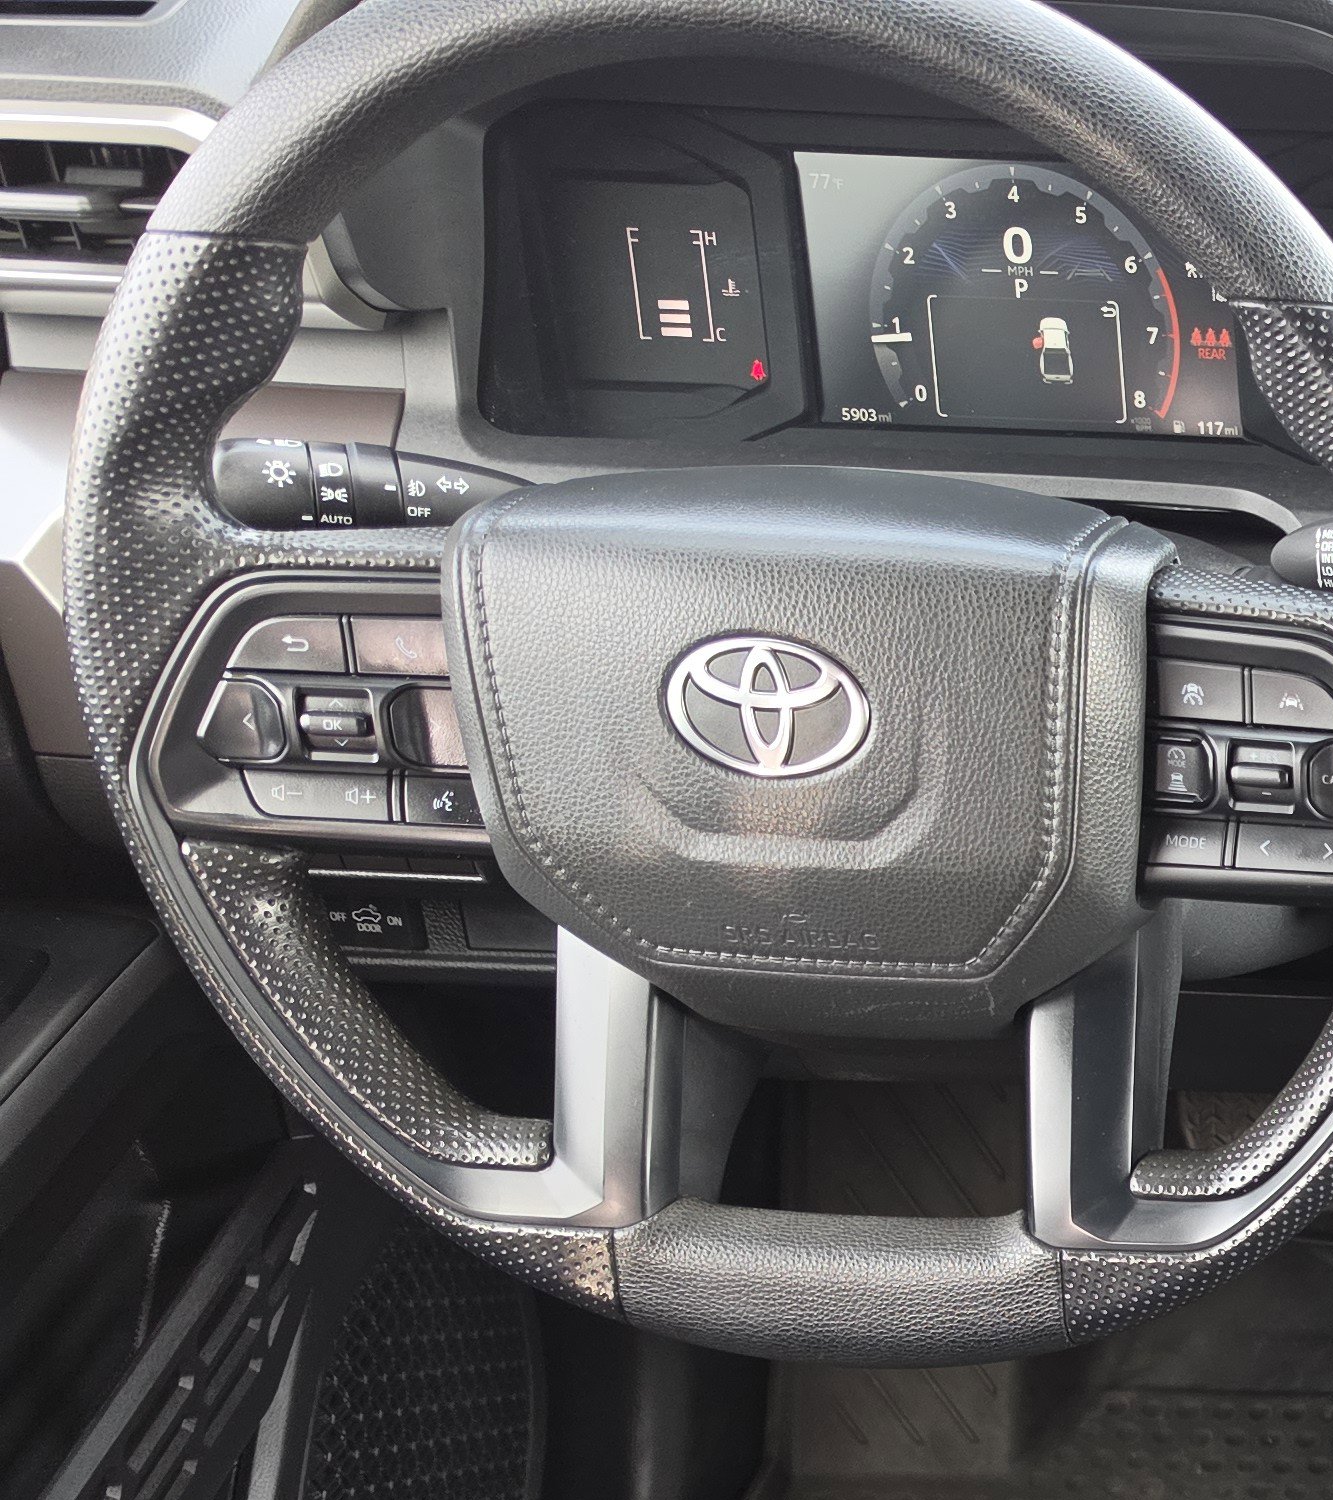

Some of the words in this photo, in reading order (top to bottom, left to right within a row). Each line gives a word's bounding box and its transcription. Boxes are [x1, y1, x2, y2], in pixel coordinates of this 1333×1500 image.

[1007, 185, 1020, 203] 4
[944, 201, 957, 219] 3
[1075, 206, 1087, 224] 5
[704, 231, 717, 247] H
[1003, 226, 1033, 264] 0
[902, 246, 916, 265] 2
[1007, 265, 1034, 277] MPH
[1124, 255, 1138, 274] 6
[1014, 278, 1029, 299] P
[891, 316, 901, 334] 1
[716, 328, 727, 342] C
[1146, 326, 1159, 345] 7
[1198, 348, 1226, 360] REAR
[914, 384, 928, 402] 0
[1133, 390, 1147, 409] 8
[320, 514, 353, 526] AUTO
[407, 506, 431, 518] OFF
[1321, 566, 1333, 577] LO
[322, 718, 343, 732] OK
[1167, 758, 1186, 769] MODE
[1165, 833, 1207, 850] MODE
[329, 911, 348, 923] OFF
[386, 916, 402, 927] ON
[357, 923, 383, 933] DOOR
